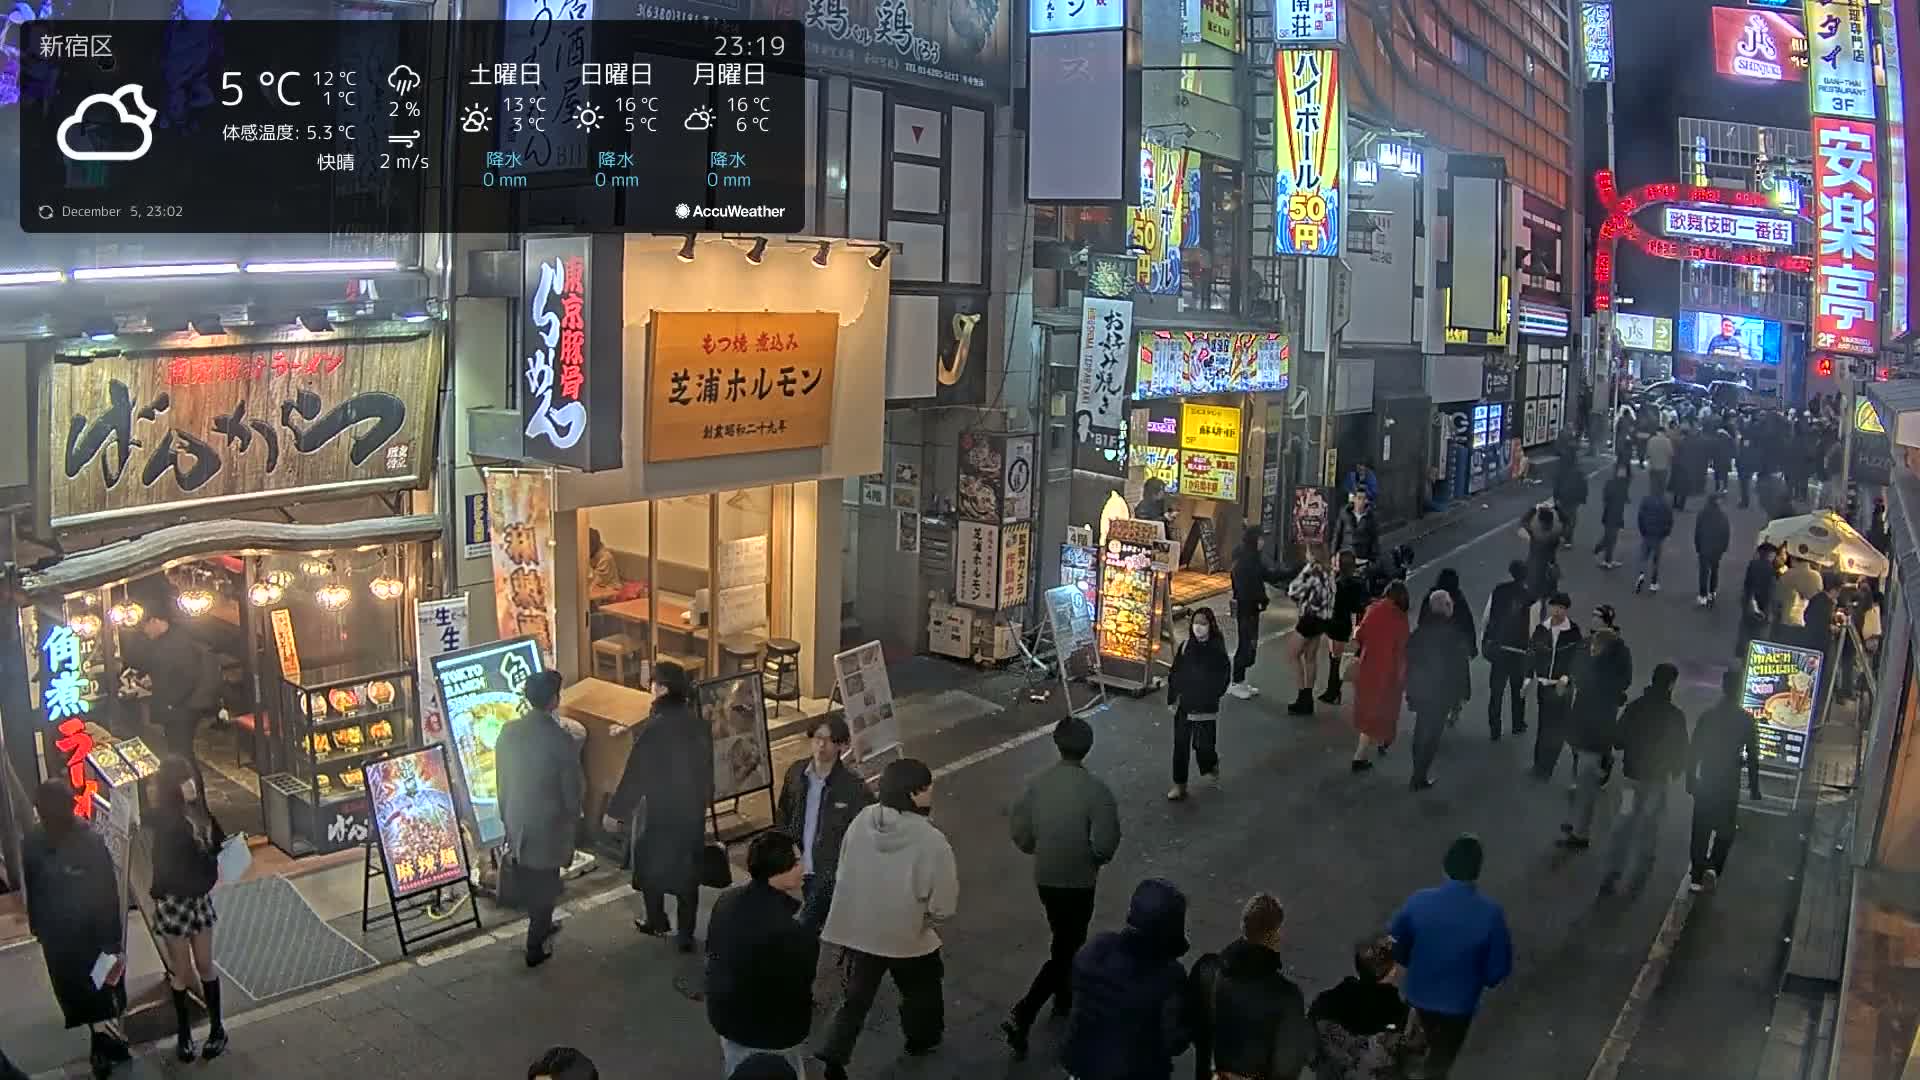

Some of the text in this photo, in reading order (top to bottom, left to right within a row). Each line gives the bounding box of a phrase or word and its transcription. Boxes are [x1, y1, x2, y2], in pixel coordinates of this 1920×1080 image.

[1817, 0, 1843, 69] タイ
[1588, 64, 1609, 79] 7F
[1296, 55, 1320, 189] ハイボール
[1832, 97, 1855, 111] 3F
[1670, 211, 1788, 242] 歌舞伎町一番街
[1818, 127, 1875, 330] 安楽亭
[561, 255, 585, 400] 東京豚骨
[702, 331, 799, 354] もつ焼 煮込み
[1817, 332, 1836, 347] 2F
[668, 366, 823, 405] 芝浦ホルモン
[1098, 310, 1125, 415] お好み焼き
[43, 625, 99, 820] 角煮ラーメ
